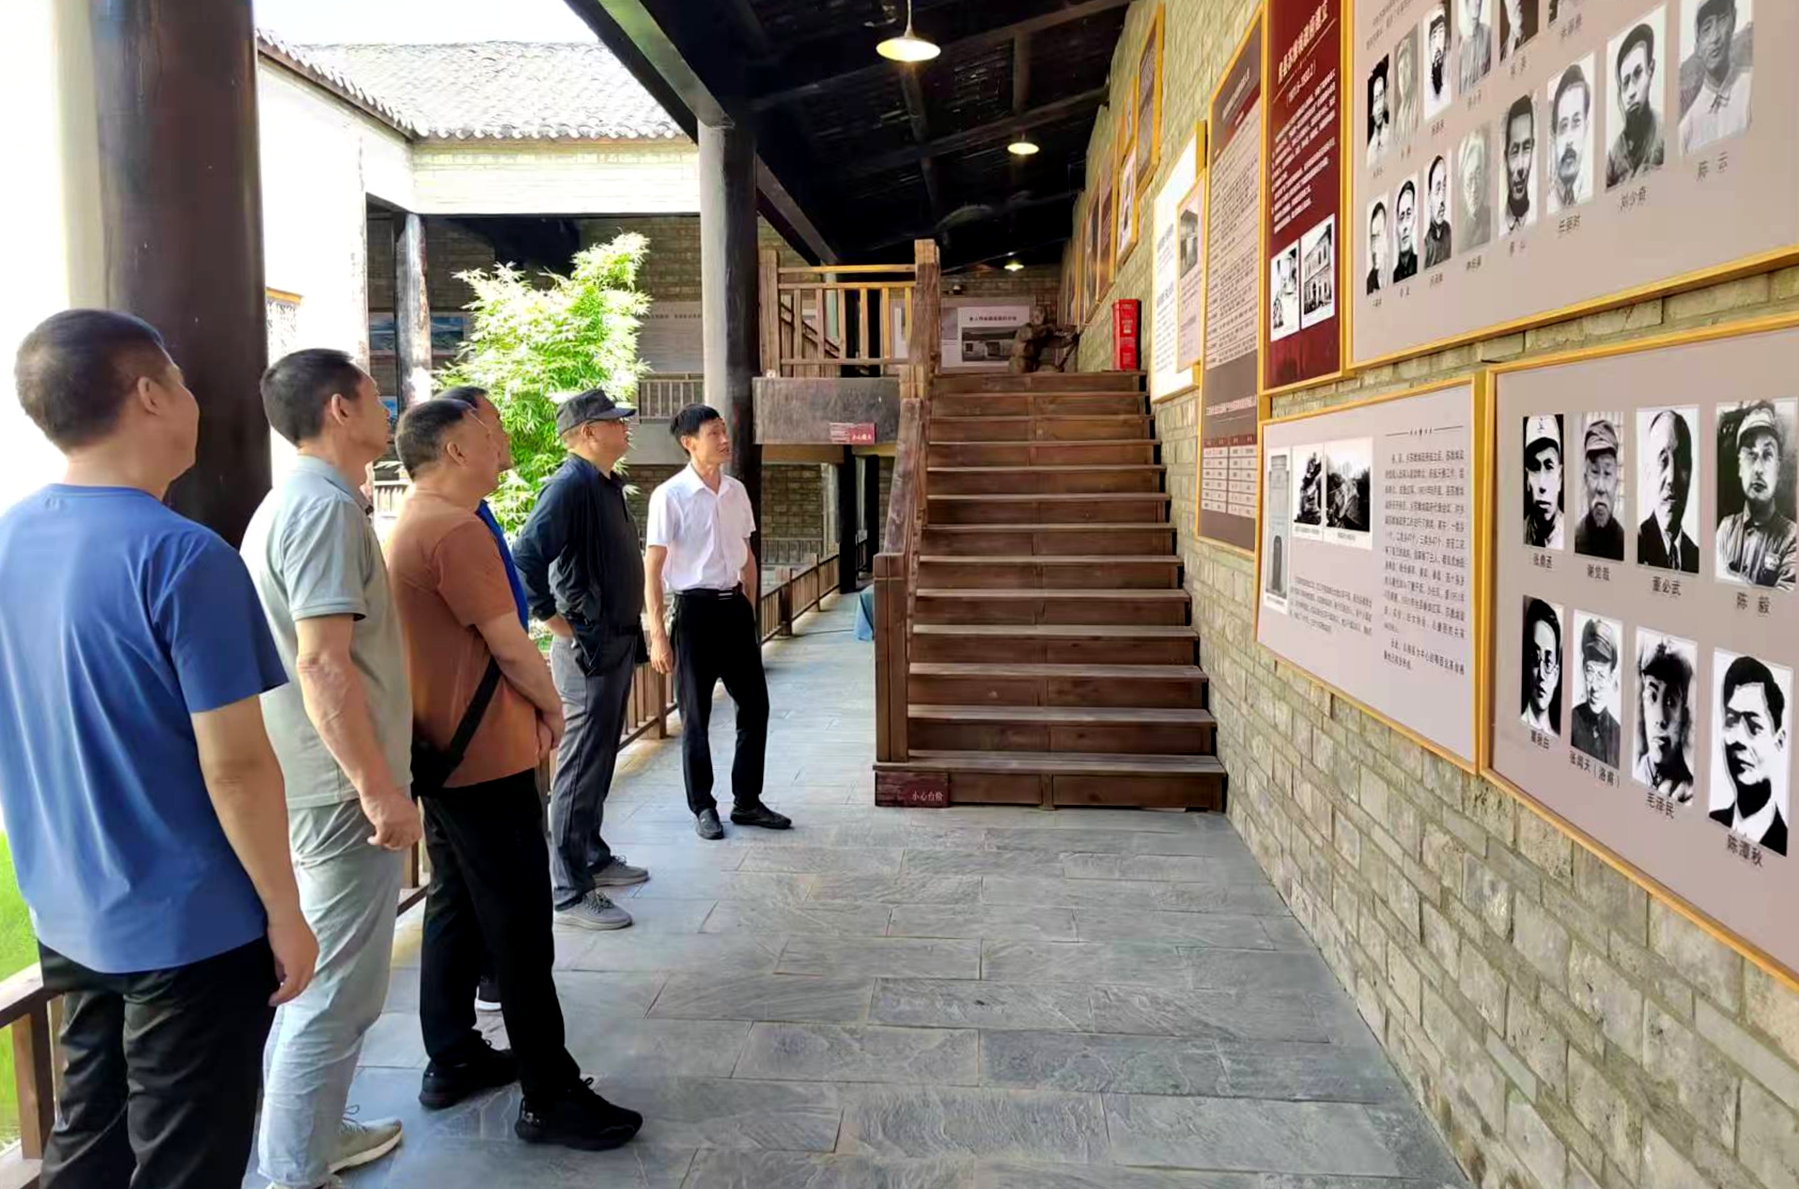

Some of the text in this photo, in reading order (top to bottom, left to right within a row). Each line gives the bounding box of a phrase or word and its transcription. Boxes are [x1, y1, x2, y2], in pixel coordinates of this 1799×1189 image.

[1619, 186, 1647, 212] 刘少奇
[1651, 575, 1682, 598] 董必武
[1727, 833, 1764, 868] 陈潭秋
